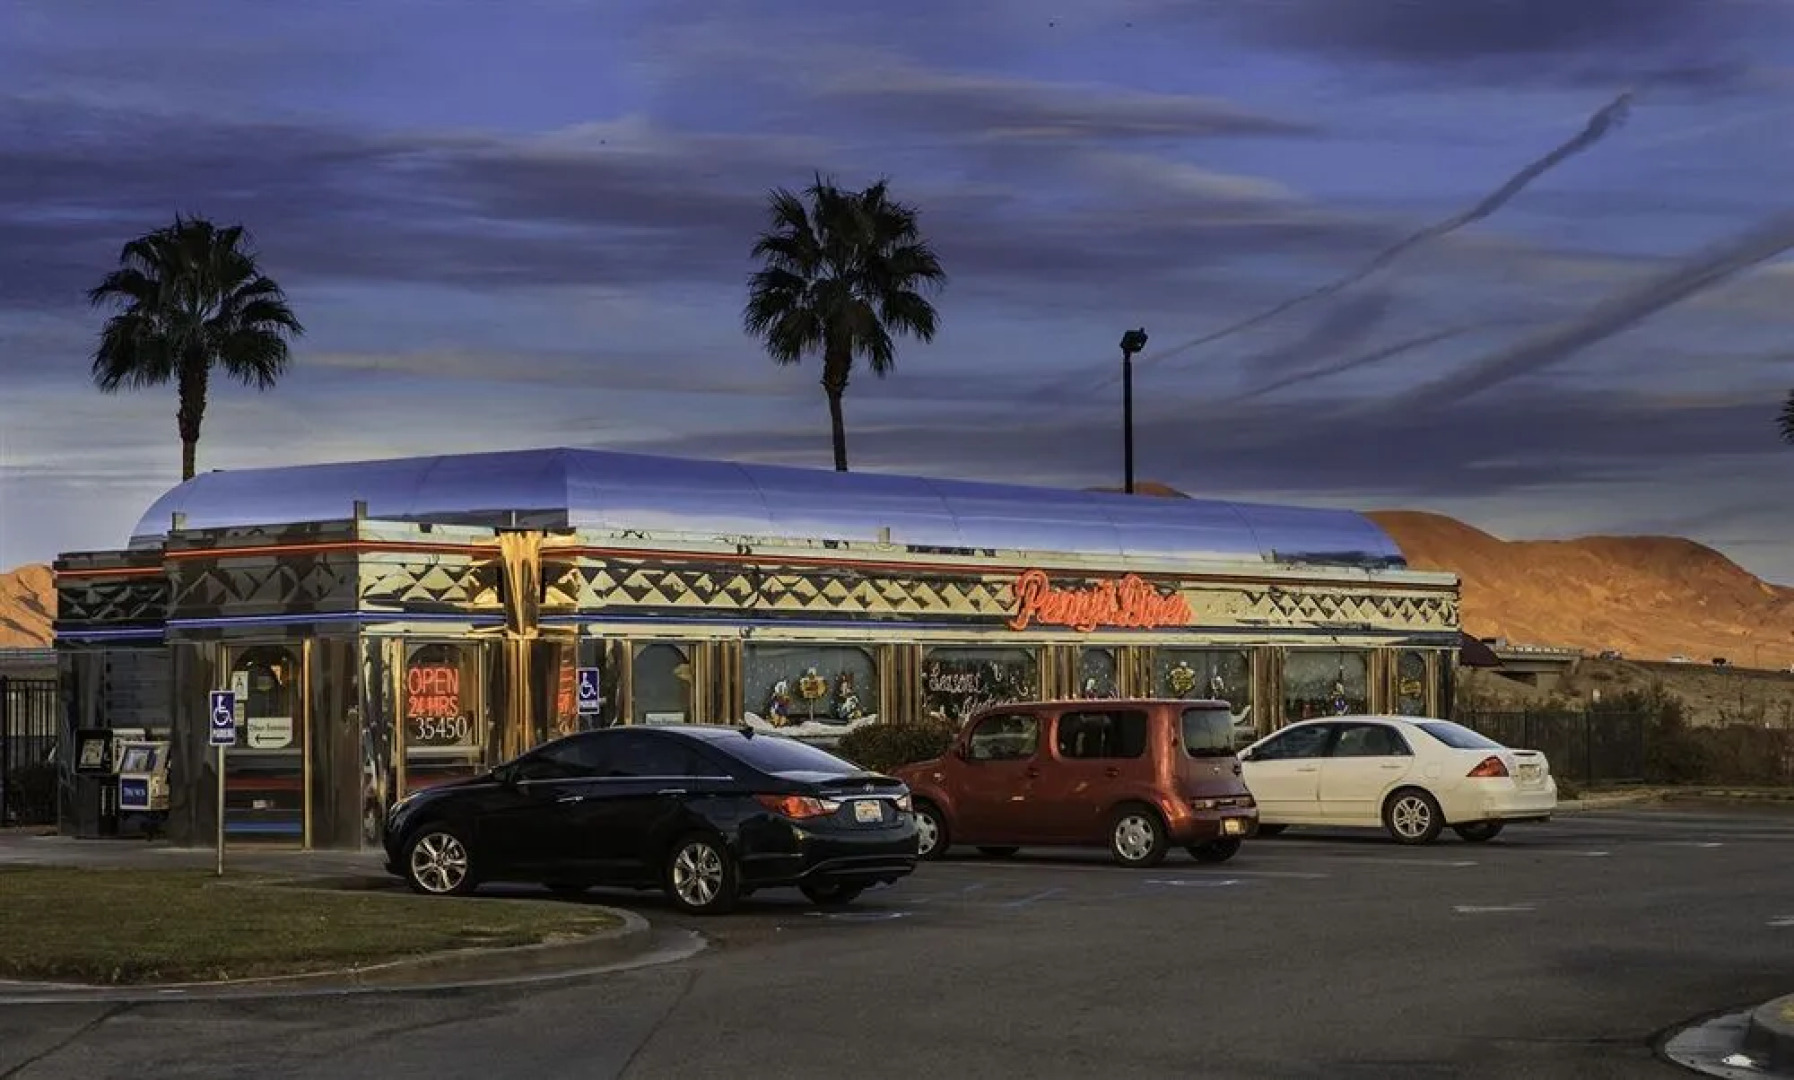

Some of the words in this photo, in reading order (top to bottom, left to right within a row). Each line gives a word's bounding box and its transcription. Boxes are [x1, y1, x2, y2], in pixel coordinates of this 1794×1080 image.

[1118, 573, 1194, 628] Diner
[408, 667, 460, 695] OPEN
[408, 695, 427, 718] 24
[428, 695, 459, 717] HRS
[415, 716, 468, 740] 35450
